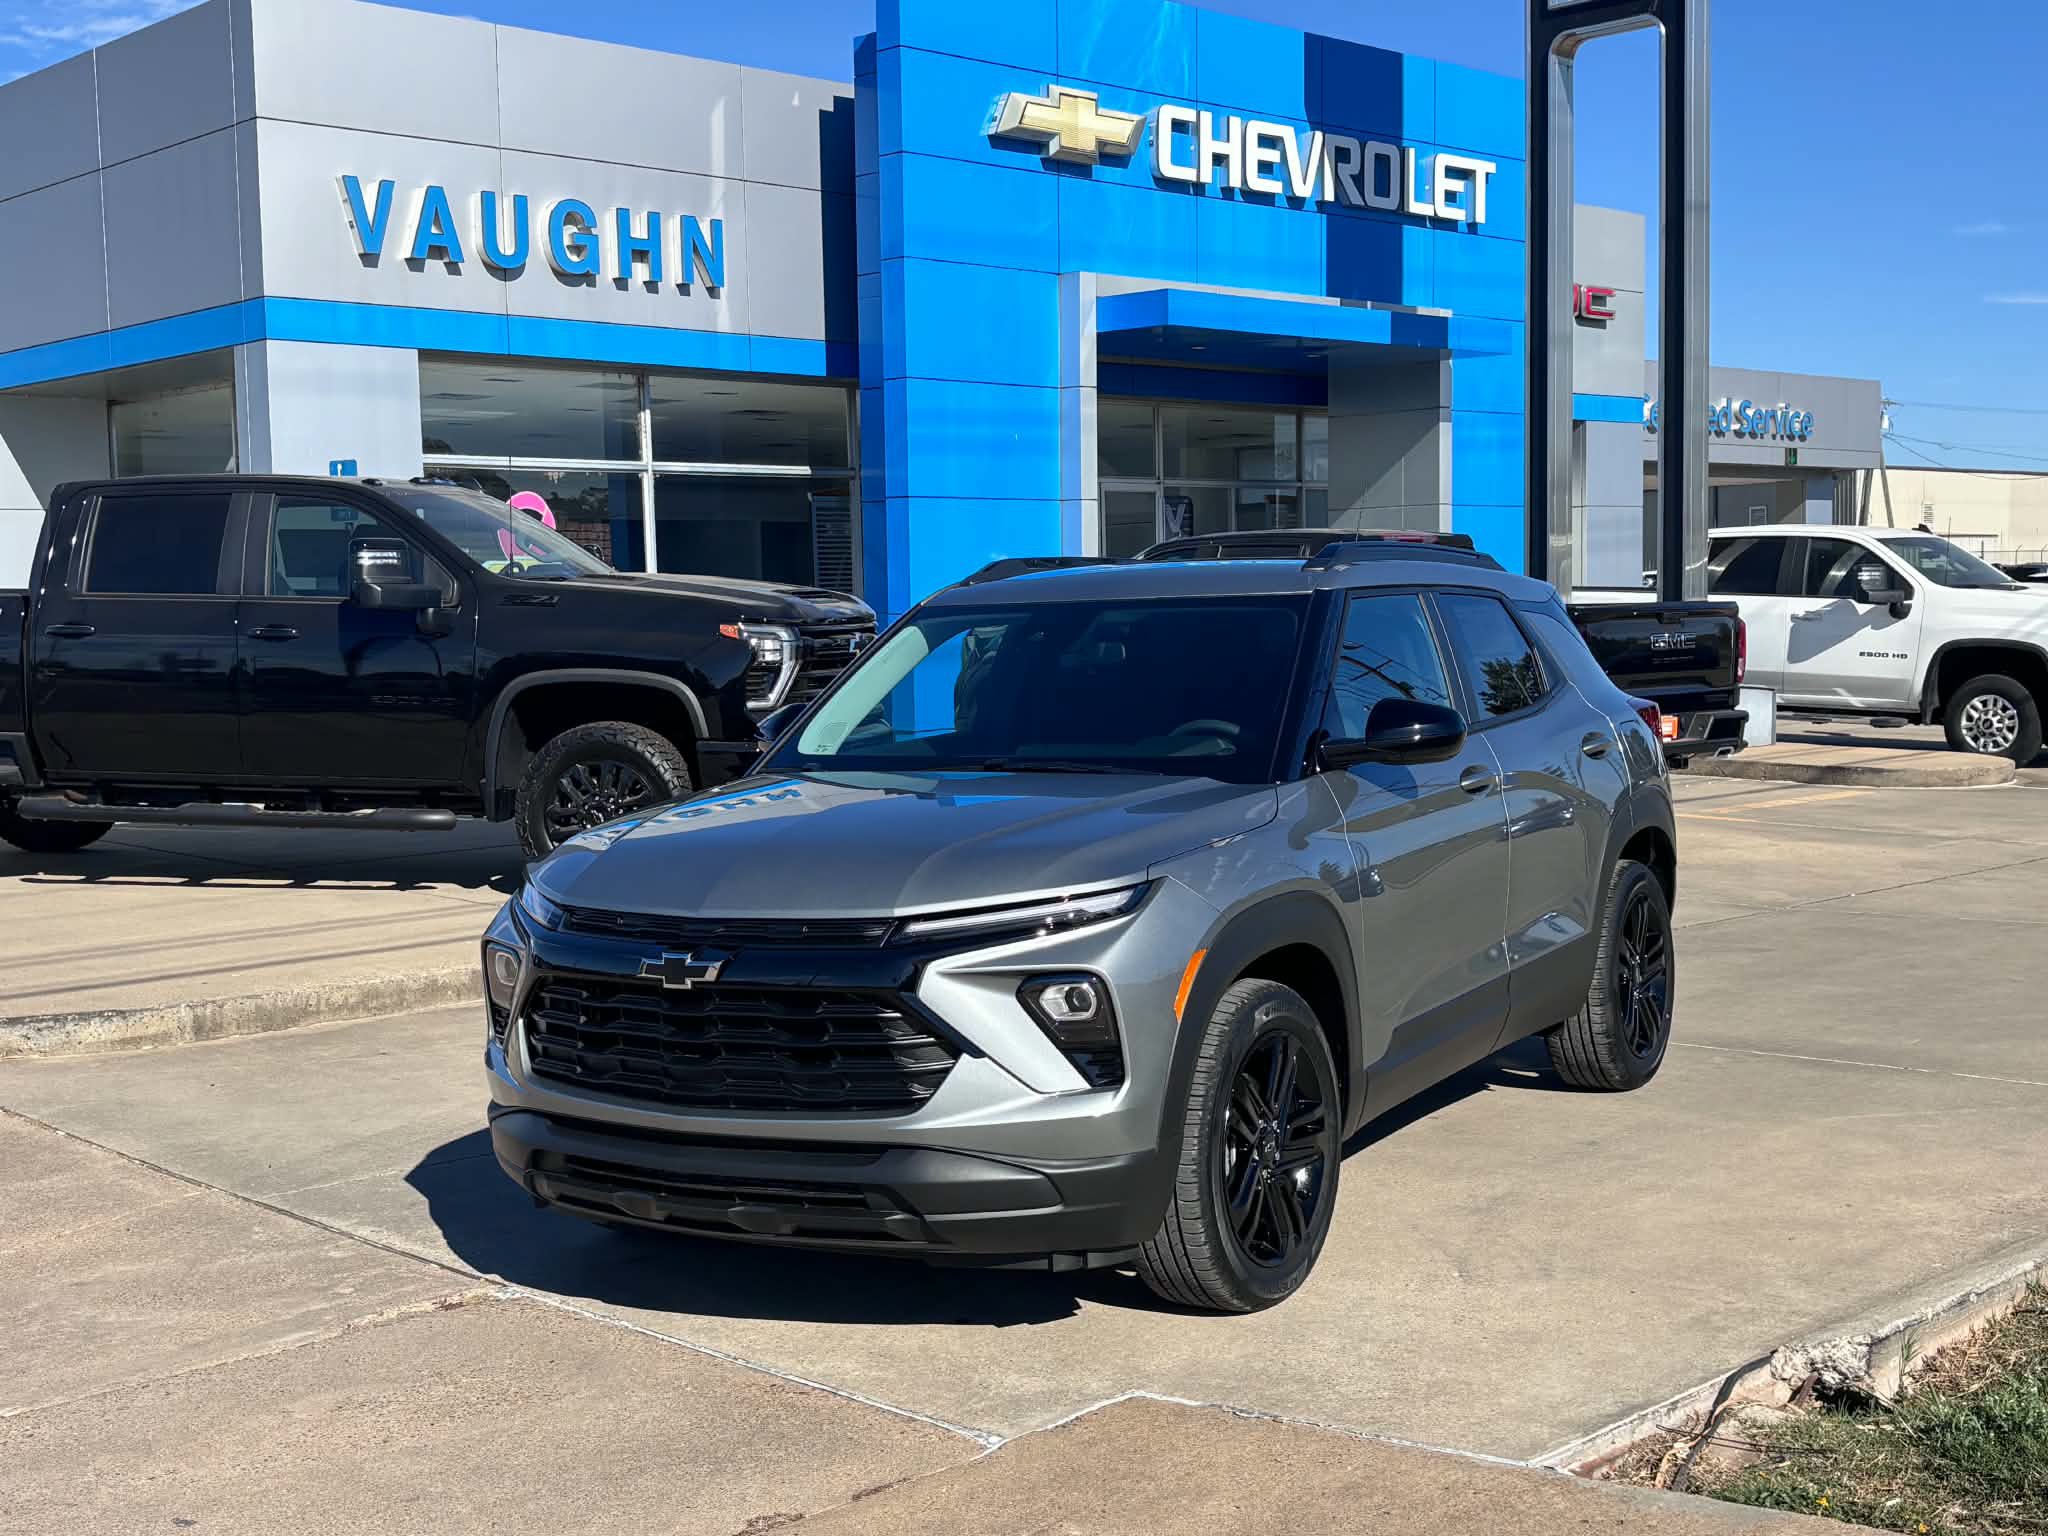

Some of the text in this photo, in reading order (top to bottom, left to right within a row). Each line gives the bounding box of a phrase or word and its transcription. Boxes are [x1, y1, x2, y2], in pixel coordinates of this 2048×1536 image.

[1154, 103, 1497, 225] CHEVROLET
[336, 174, 725, 289] VAUGHN
[1740, 399, 1814, 437] Service
[1650, 632, 1697, 650] GMC
[1891, 652, 1909, 660] HD
